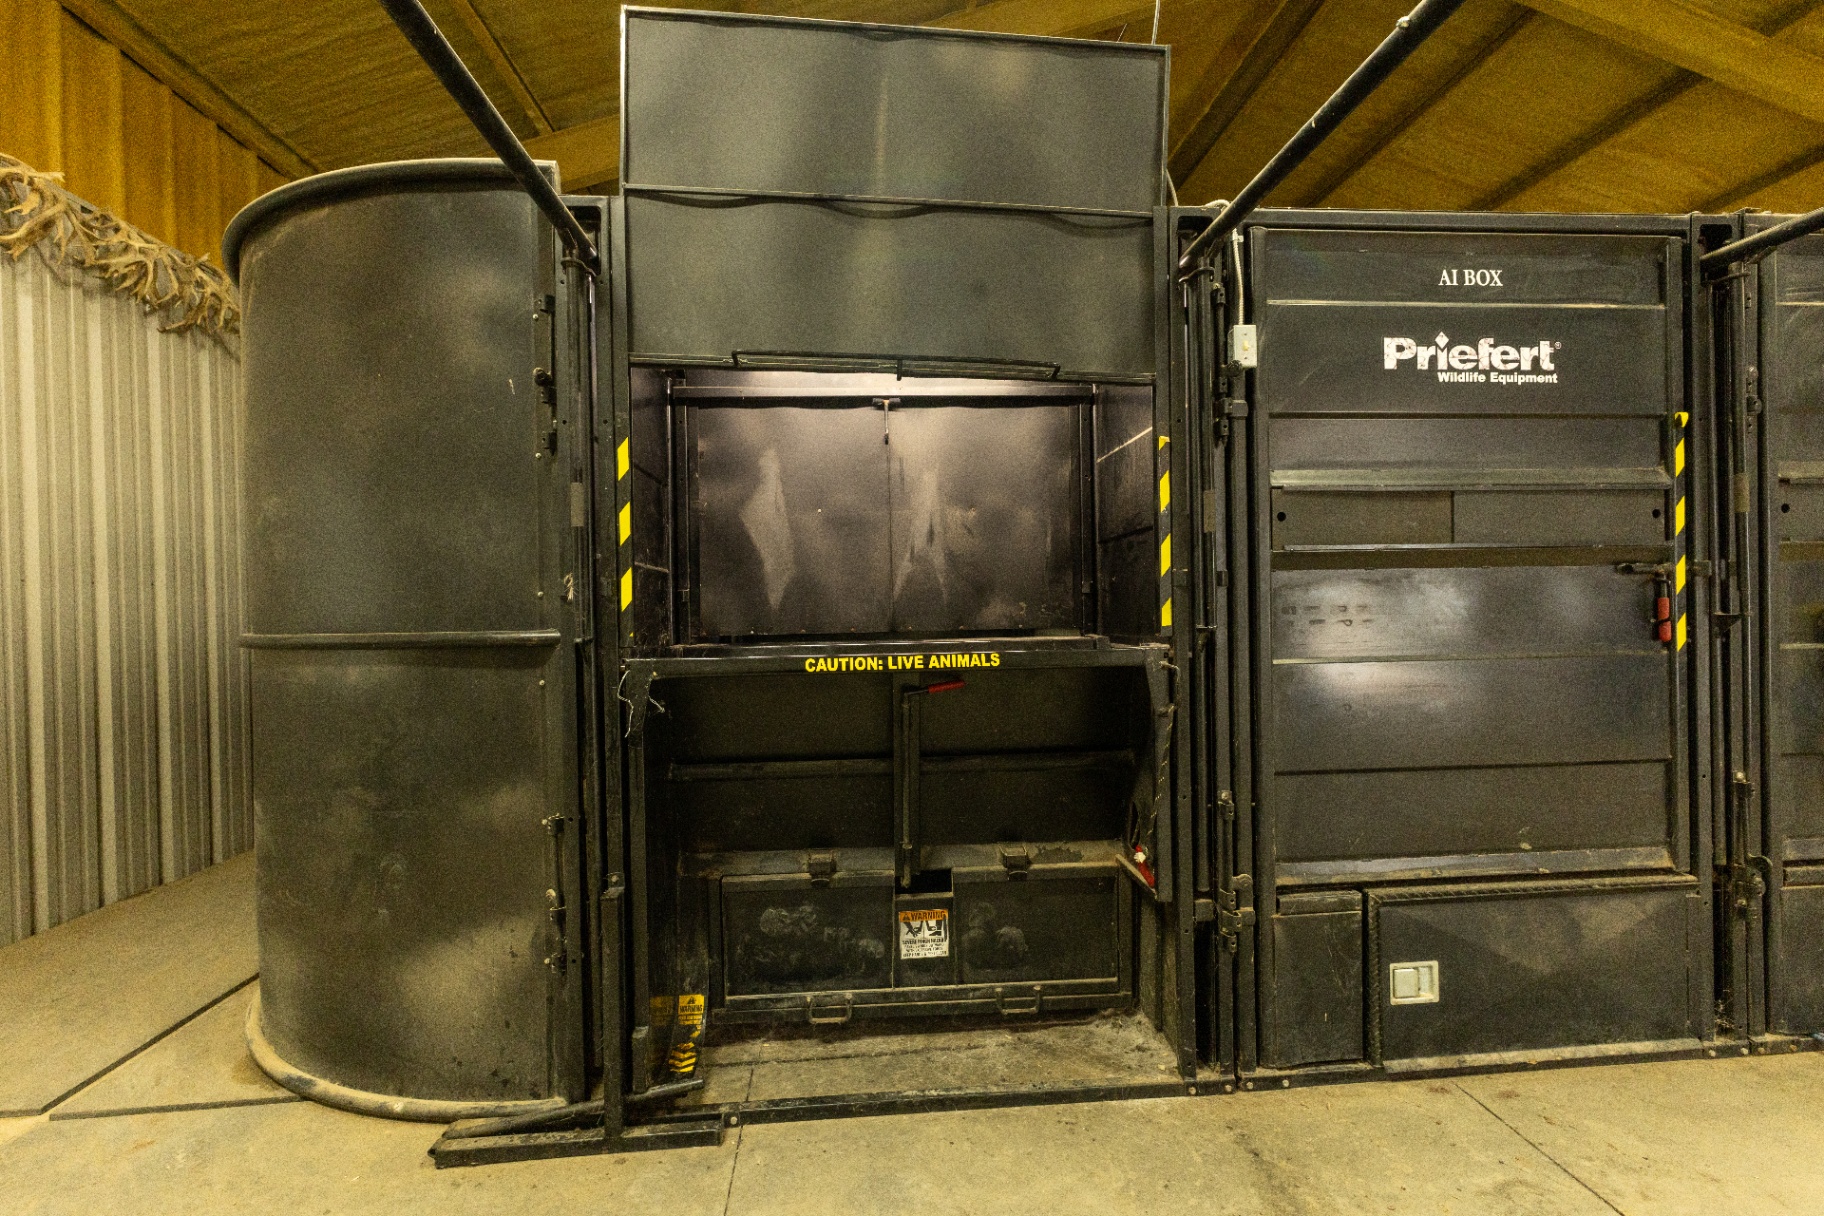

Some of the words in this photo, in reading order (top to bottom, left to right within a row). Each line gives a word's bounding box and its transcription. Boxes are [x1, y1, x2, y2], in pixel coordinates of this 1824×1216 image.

[1438, 269, 1458, 286] AI
[1463, 269, 1503, 287] BOX
[1437, 371, 1486, 383] Wildlife
[1490, 371, 1558, 385] Equipment
[804, 656, 883, 673] CAUTION:
[887, 654, 924, 670] LIVE
[928, 652, 1000, 669] ANIMALS
[911, 910, 945, 921] WARNING
[679, 1004, 703, 1013] WARNING
